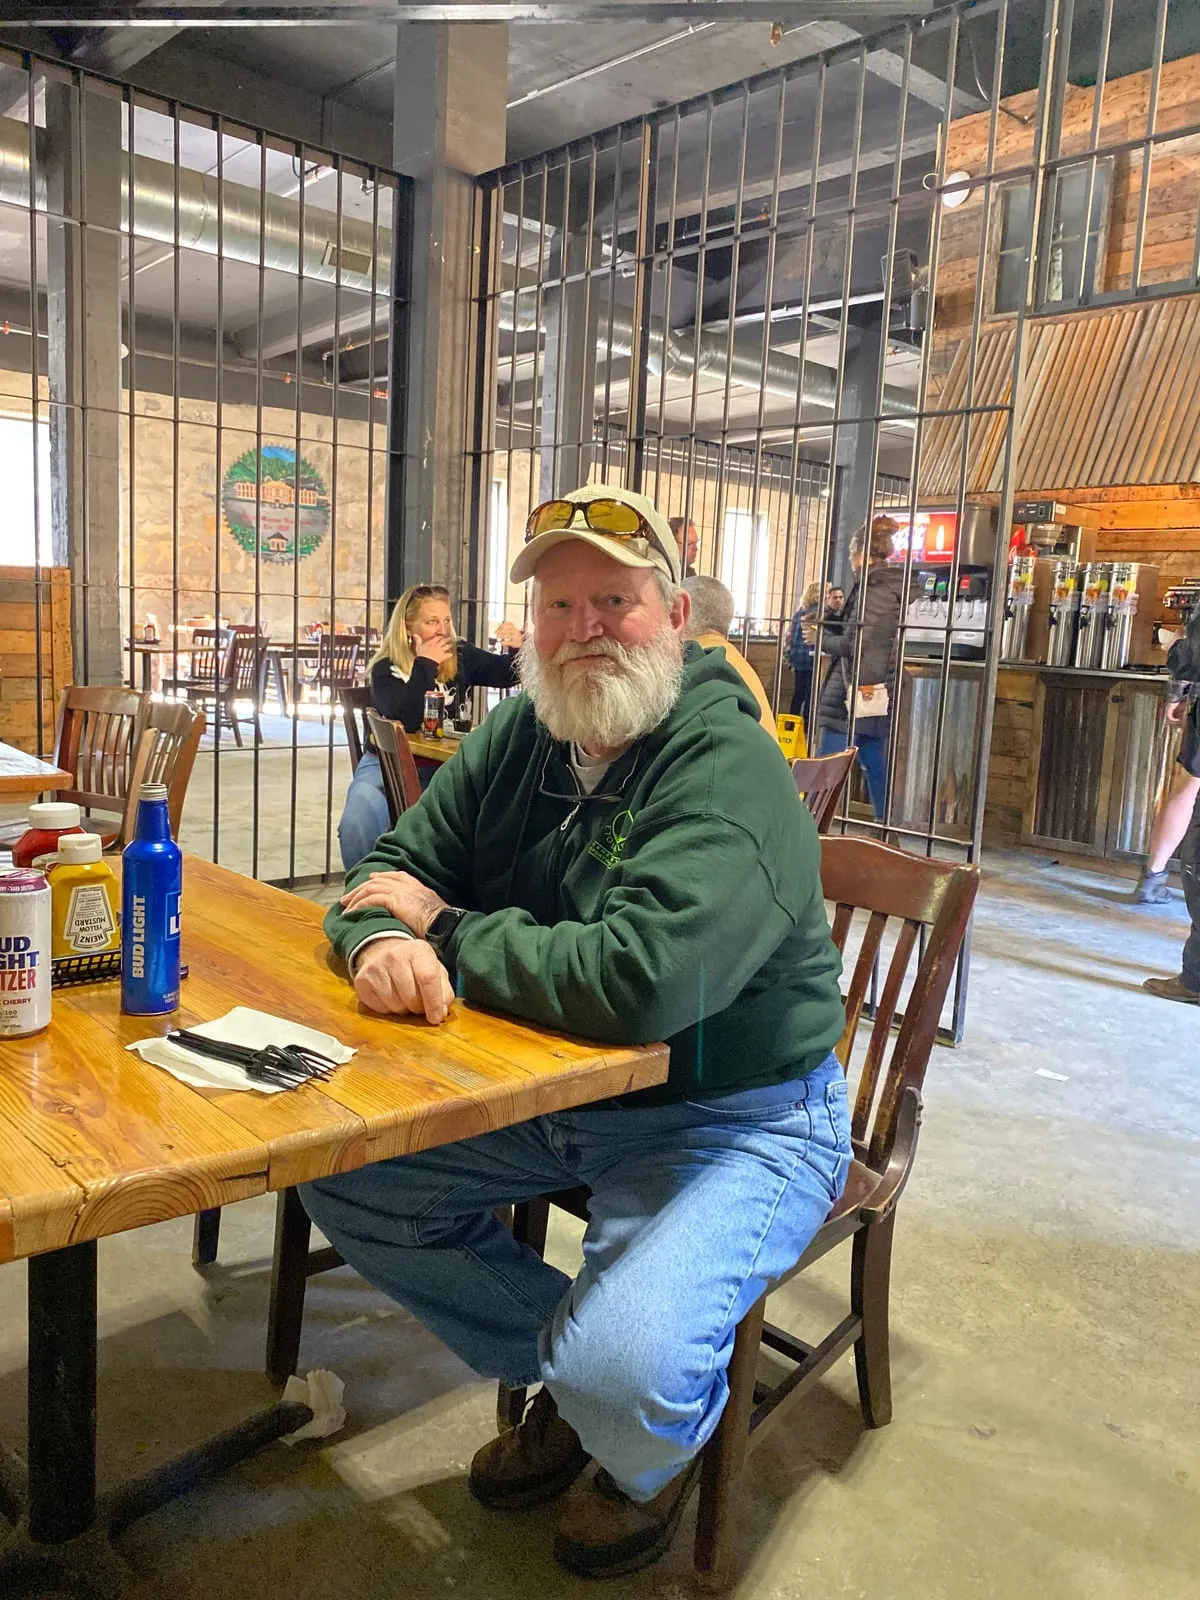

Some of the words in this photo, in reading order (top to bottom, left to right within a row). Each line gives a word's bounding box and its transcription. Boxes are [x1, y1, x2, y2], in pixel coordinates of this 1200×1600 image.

[75, 916, 106, 926] MUSTARD
[132, 895, 146, 943] LIGHT
[80, 924, 103, 933] YELLOW
[79, 933, 104, 943] HEINZ
[132, 944, 145, 978] BUD
[2, 997, 31, 1006] CHERRY
